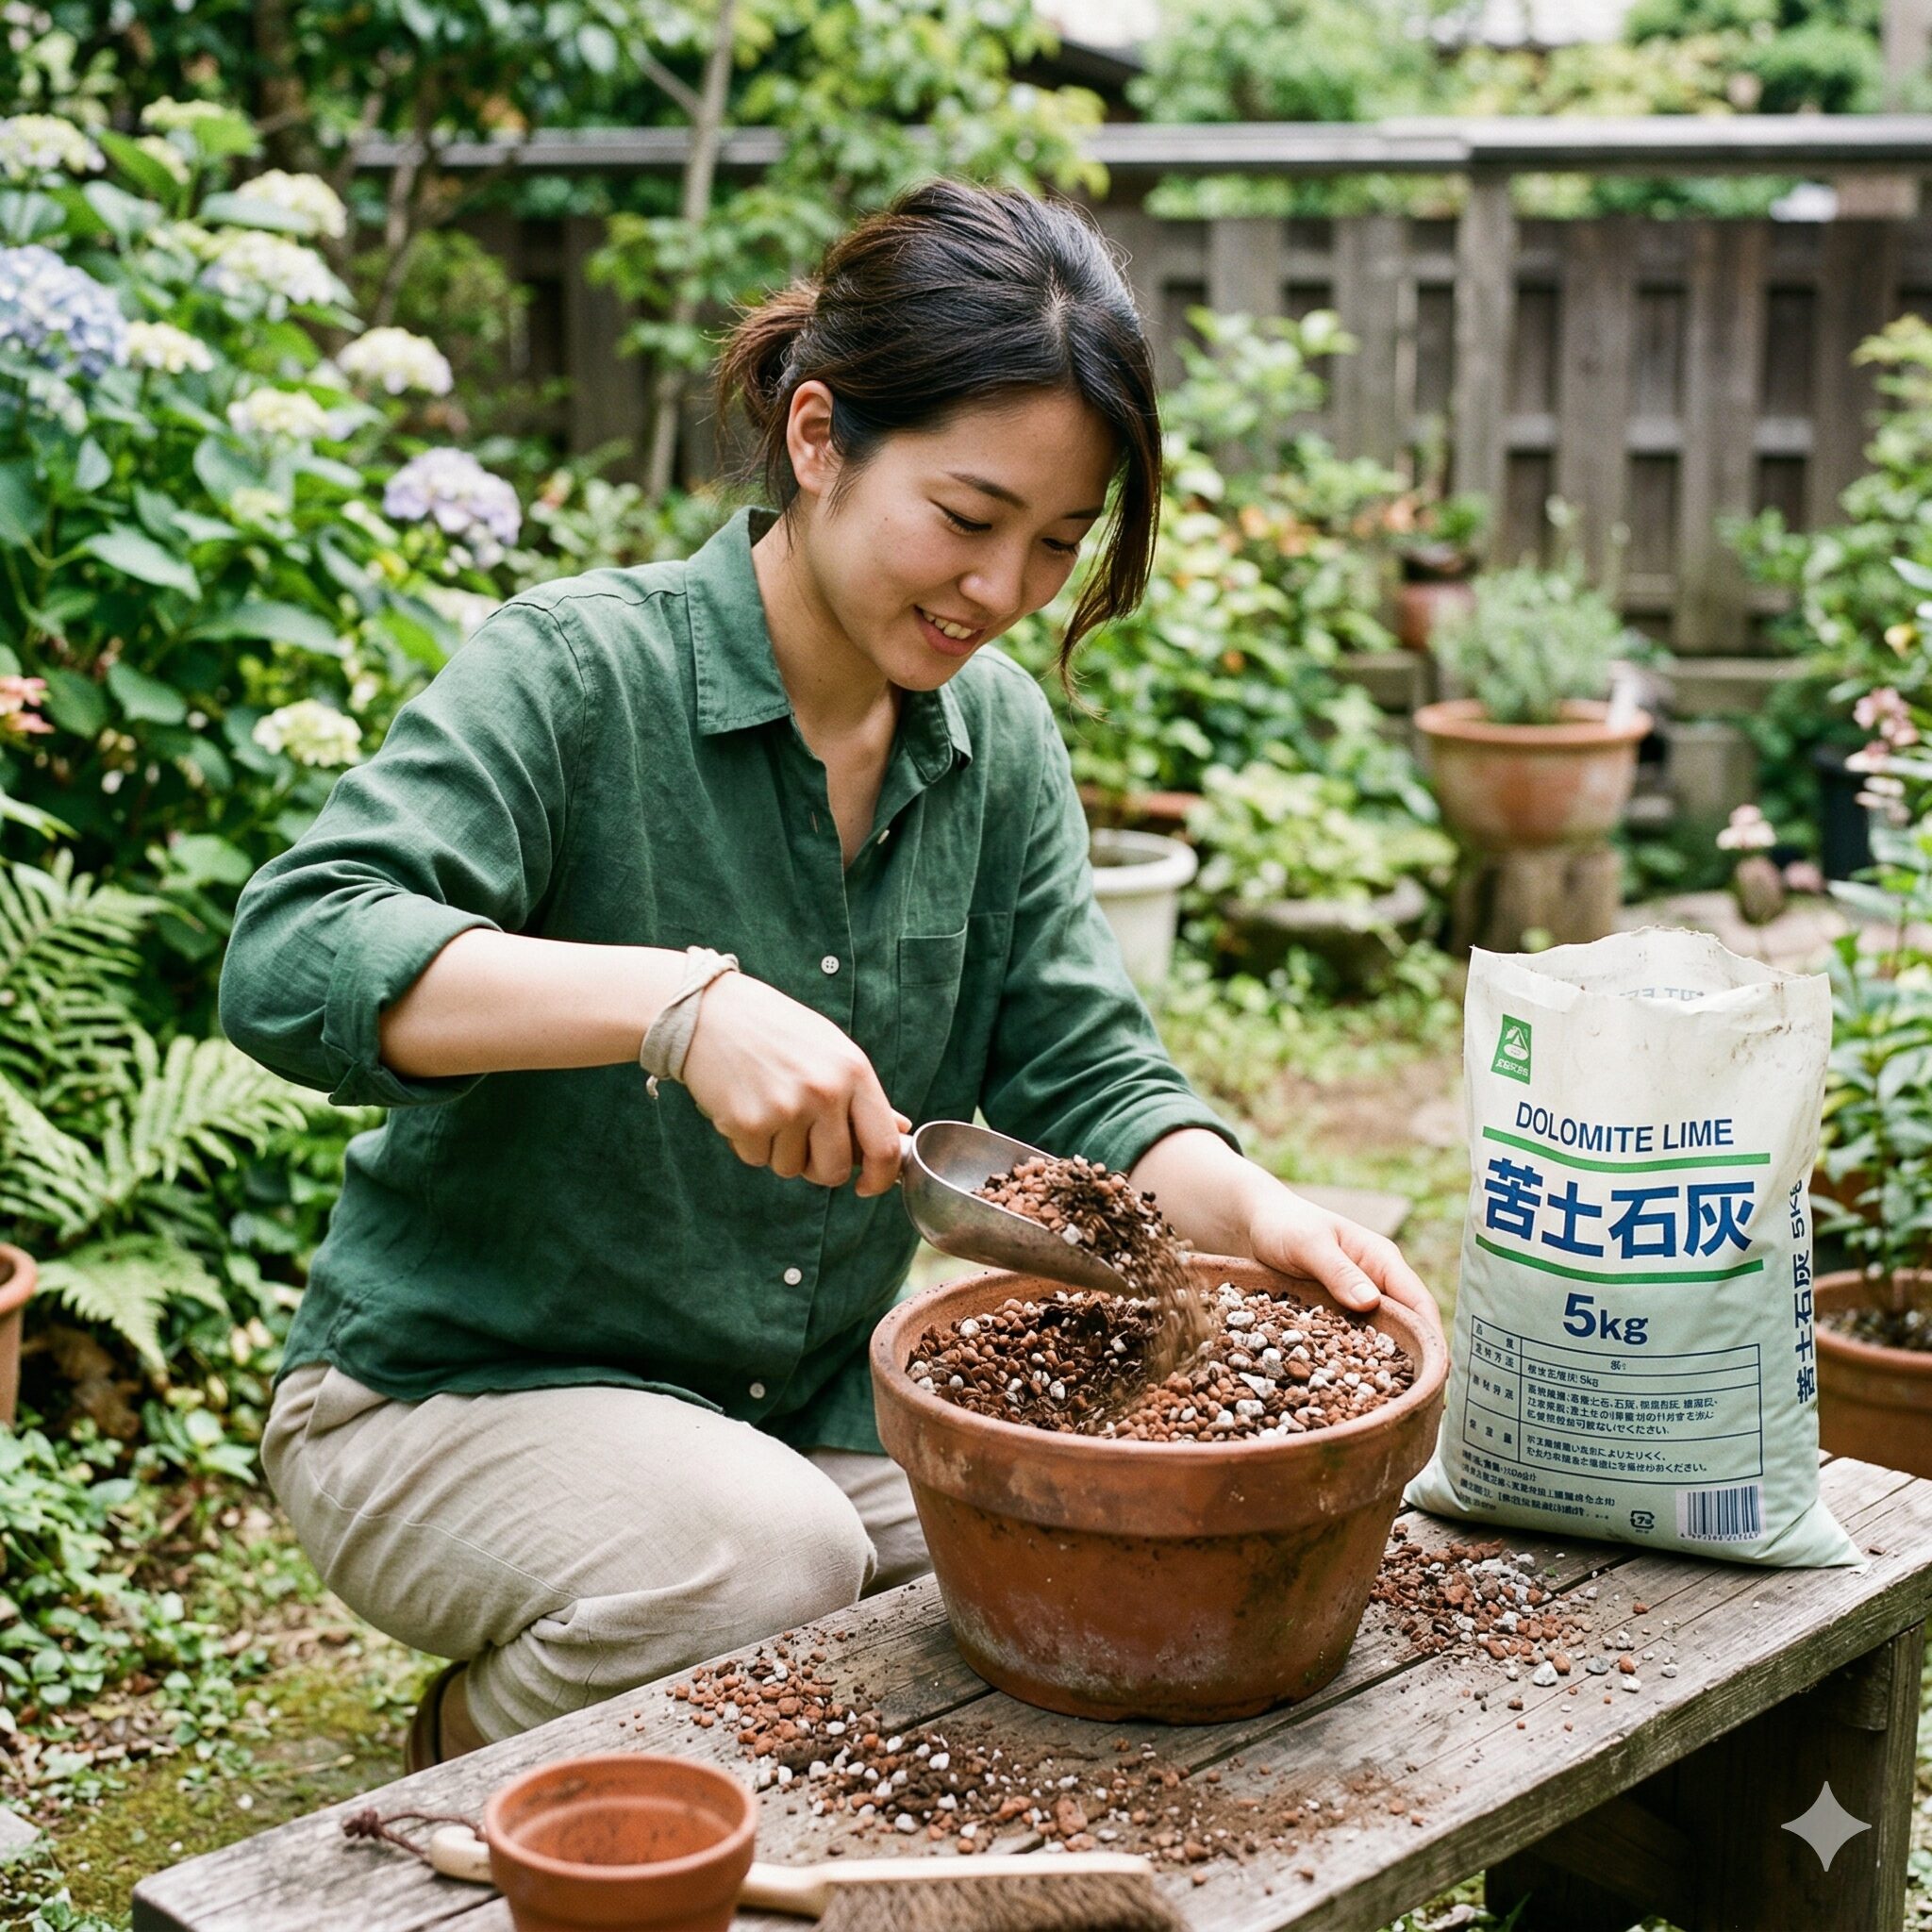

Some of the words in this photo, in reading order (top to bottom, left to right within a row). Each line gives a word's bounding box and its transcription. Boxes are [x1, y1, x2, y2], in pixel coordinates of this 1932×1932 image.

[1515, 1101, 1654, 1153] DOLOMITE
[1663, 1119, 1734, 1150] LIME
[1484, 1158, 1755, 1259] 苦土石灰
[1563, 1292, 1649, 1345] 5kg
[1792, 1250, 1816, 1405] 苦土石灰
